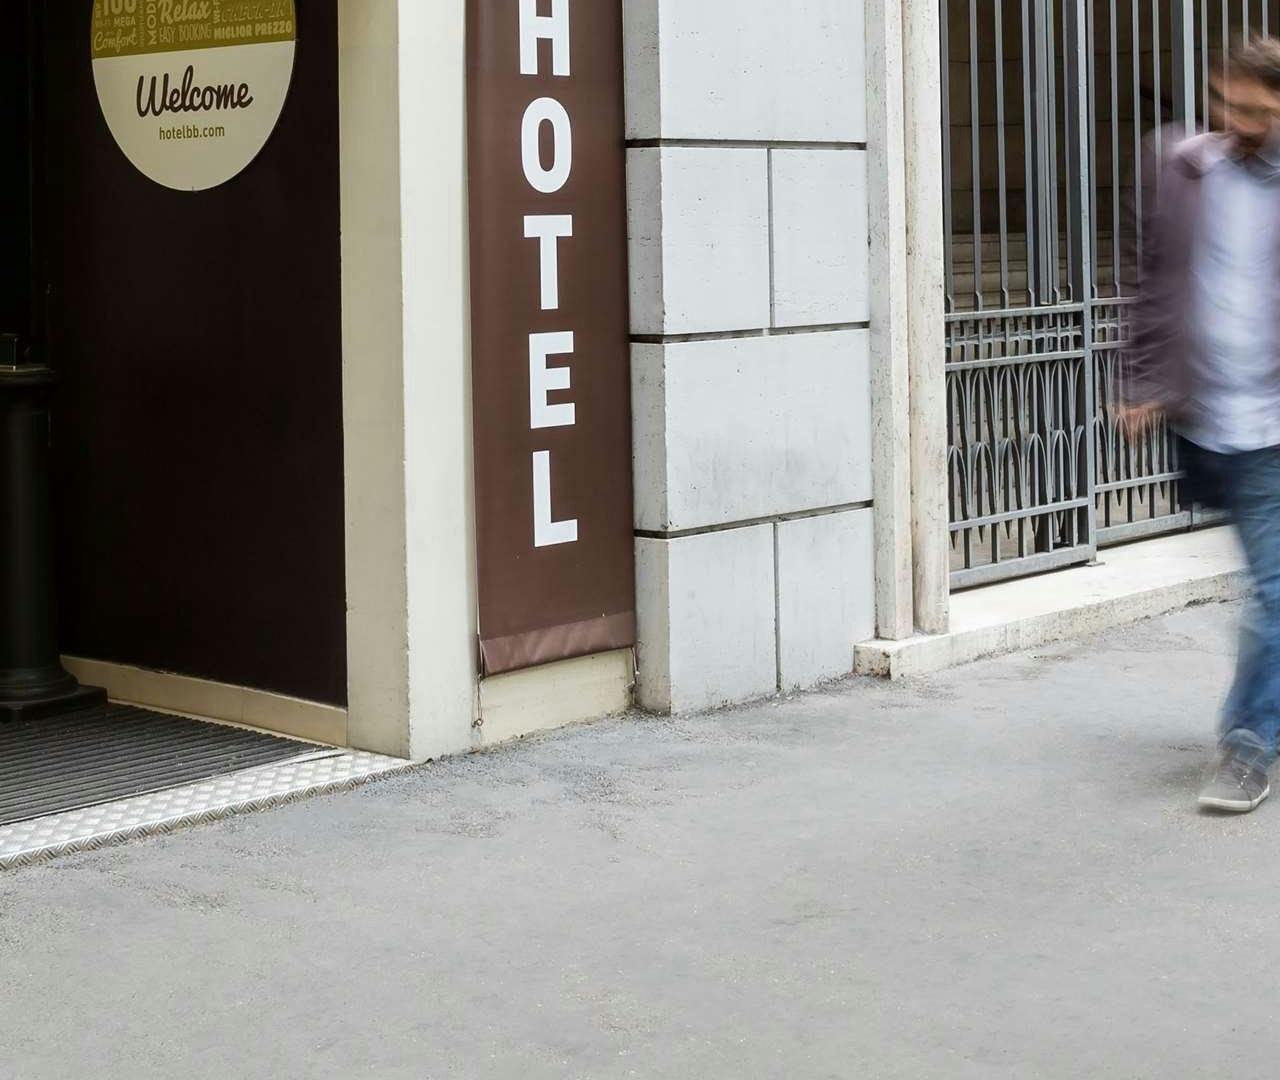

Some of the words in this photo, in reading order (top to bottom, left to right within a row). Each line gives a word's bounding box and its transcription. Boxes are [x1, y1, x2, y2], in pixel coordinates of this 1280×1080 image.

[113, 15, 136, 26] MEGA
[213, 24, 252, 41] MIGLIOR
[255, 20, 293, 36] PREZZO
[94, 28, 138, 53] Comfort
[178, 23, 212, 42] BOOKING
[136, 64, 254, 118] Welcome
[159, 123, 225, 141] hotelbb.com
